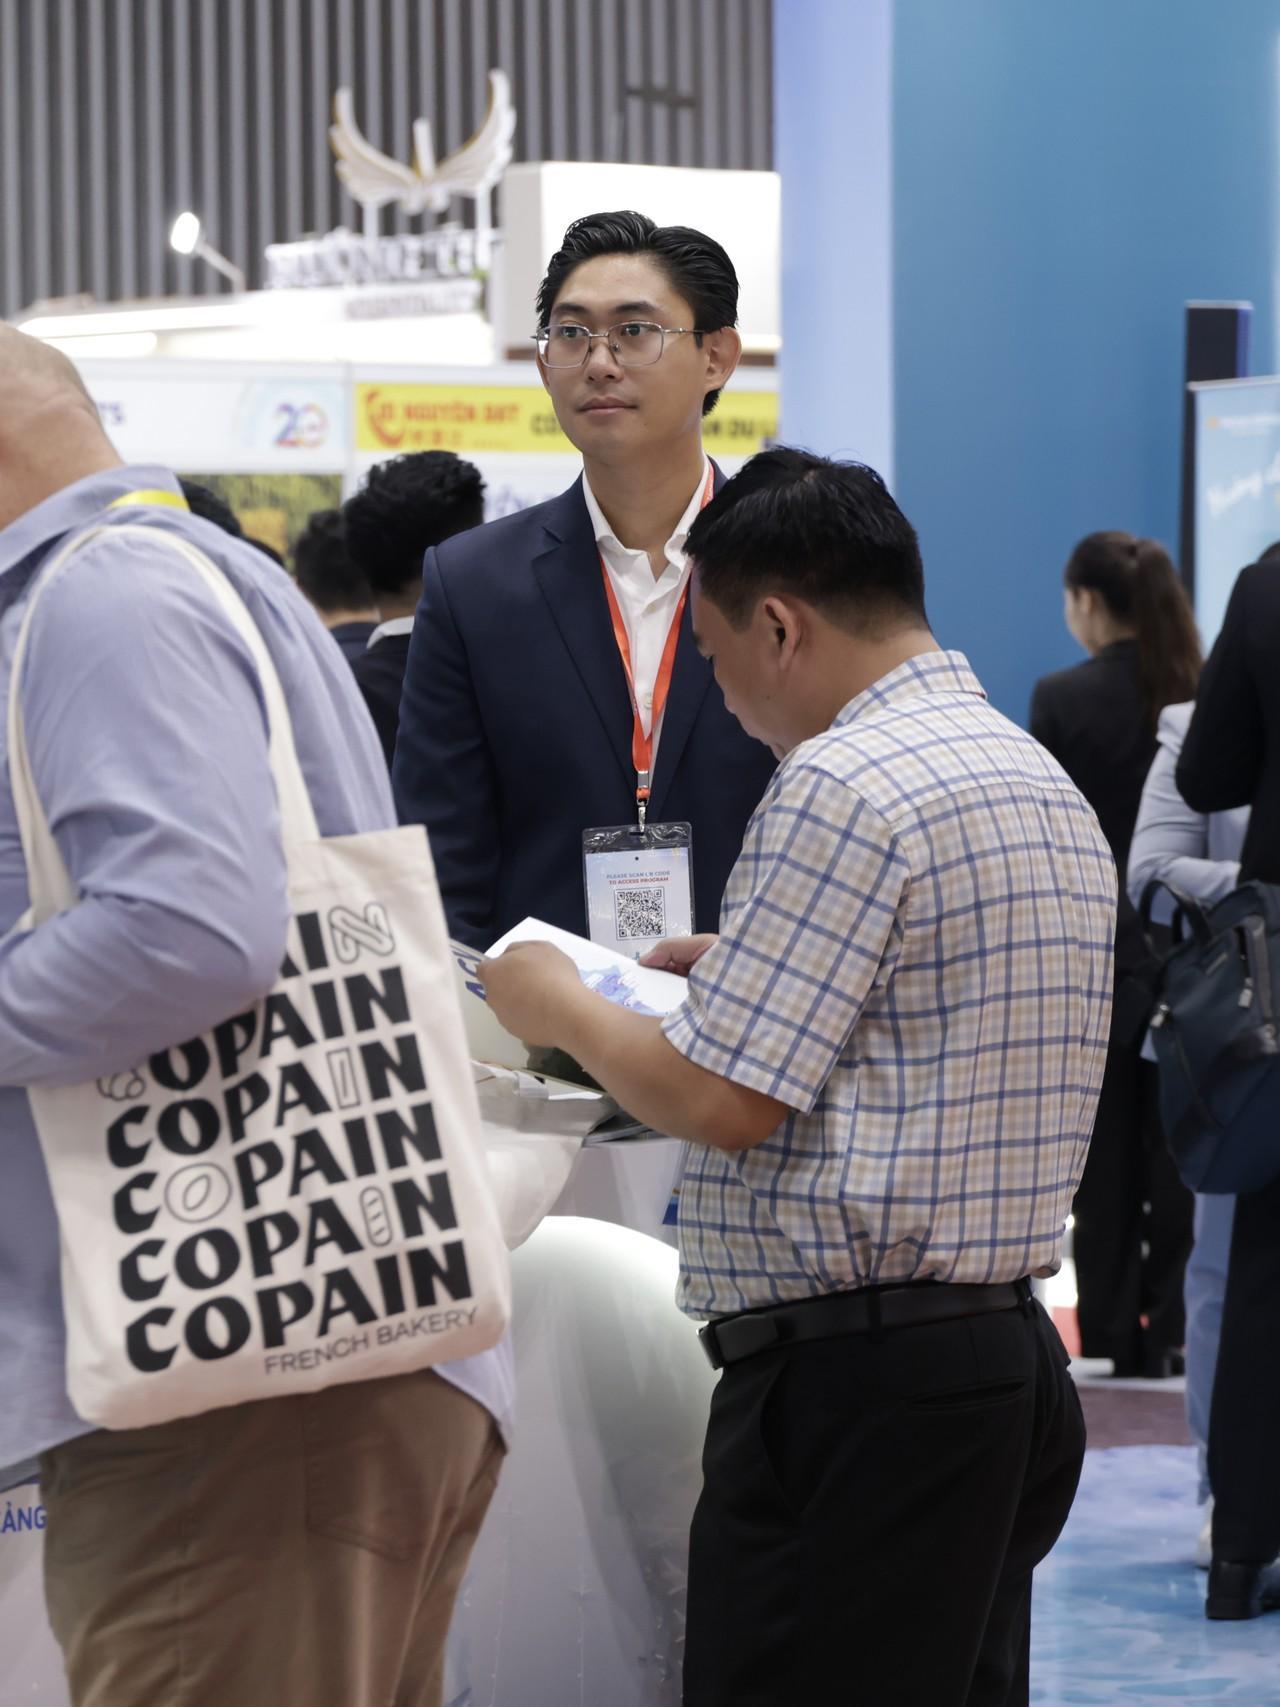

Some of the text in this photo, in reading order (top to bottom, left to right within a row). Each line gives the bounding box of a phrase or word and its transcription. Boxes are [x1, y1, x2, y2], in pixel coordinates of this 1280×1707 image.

[106, 1033, 427, 1168] COPAIN
[113, 1100, 443, 1234] COPAIN
[120, 1170, 459, 1301] COPAIN
[125, 1241, 473, 1373] COPAIN
[264, 1305, 479, 1375] FRENCH BAKERY
